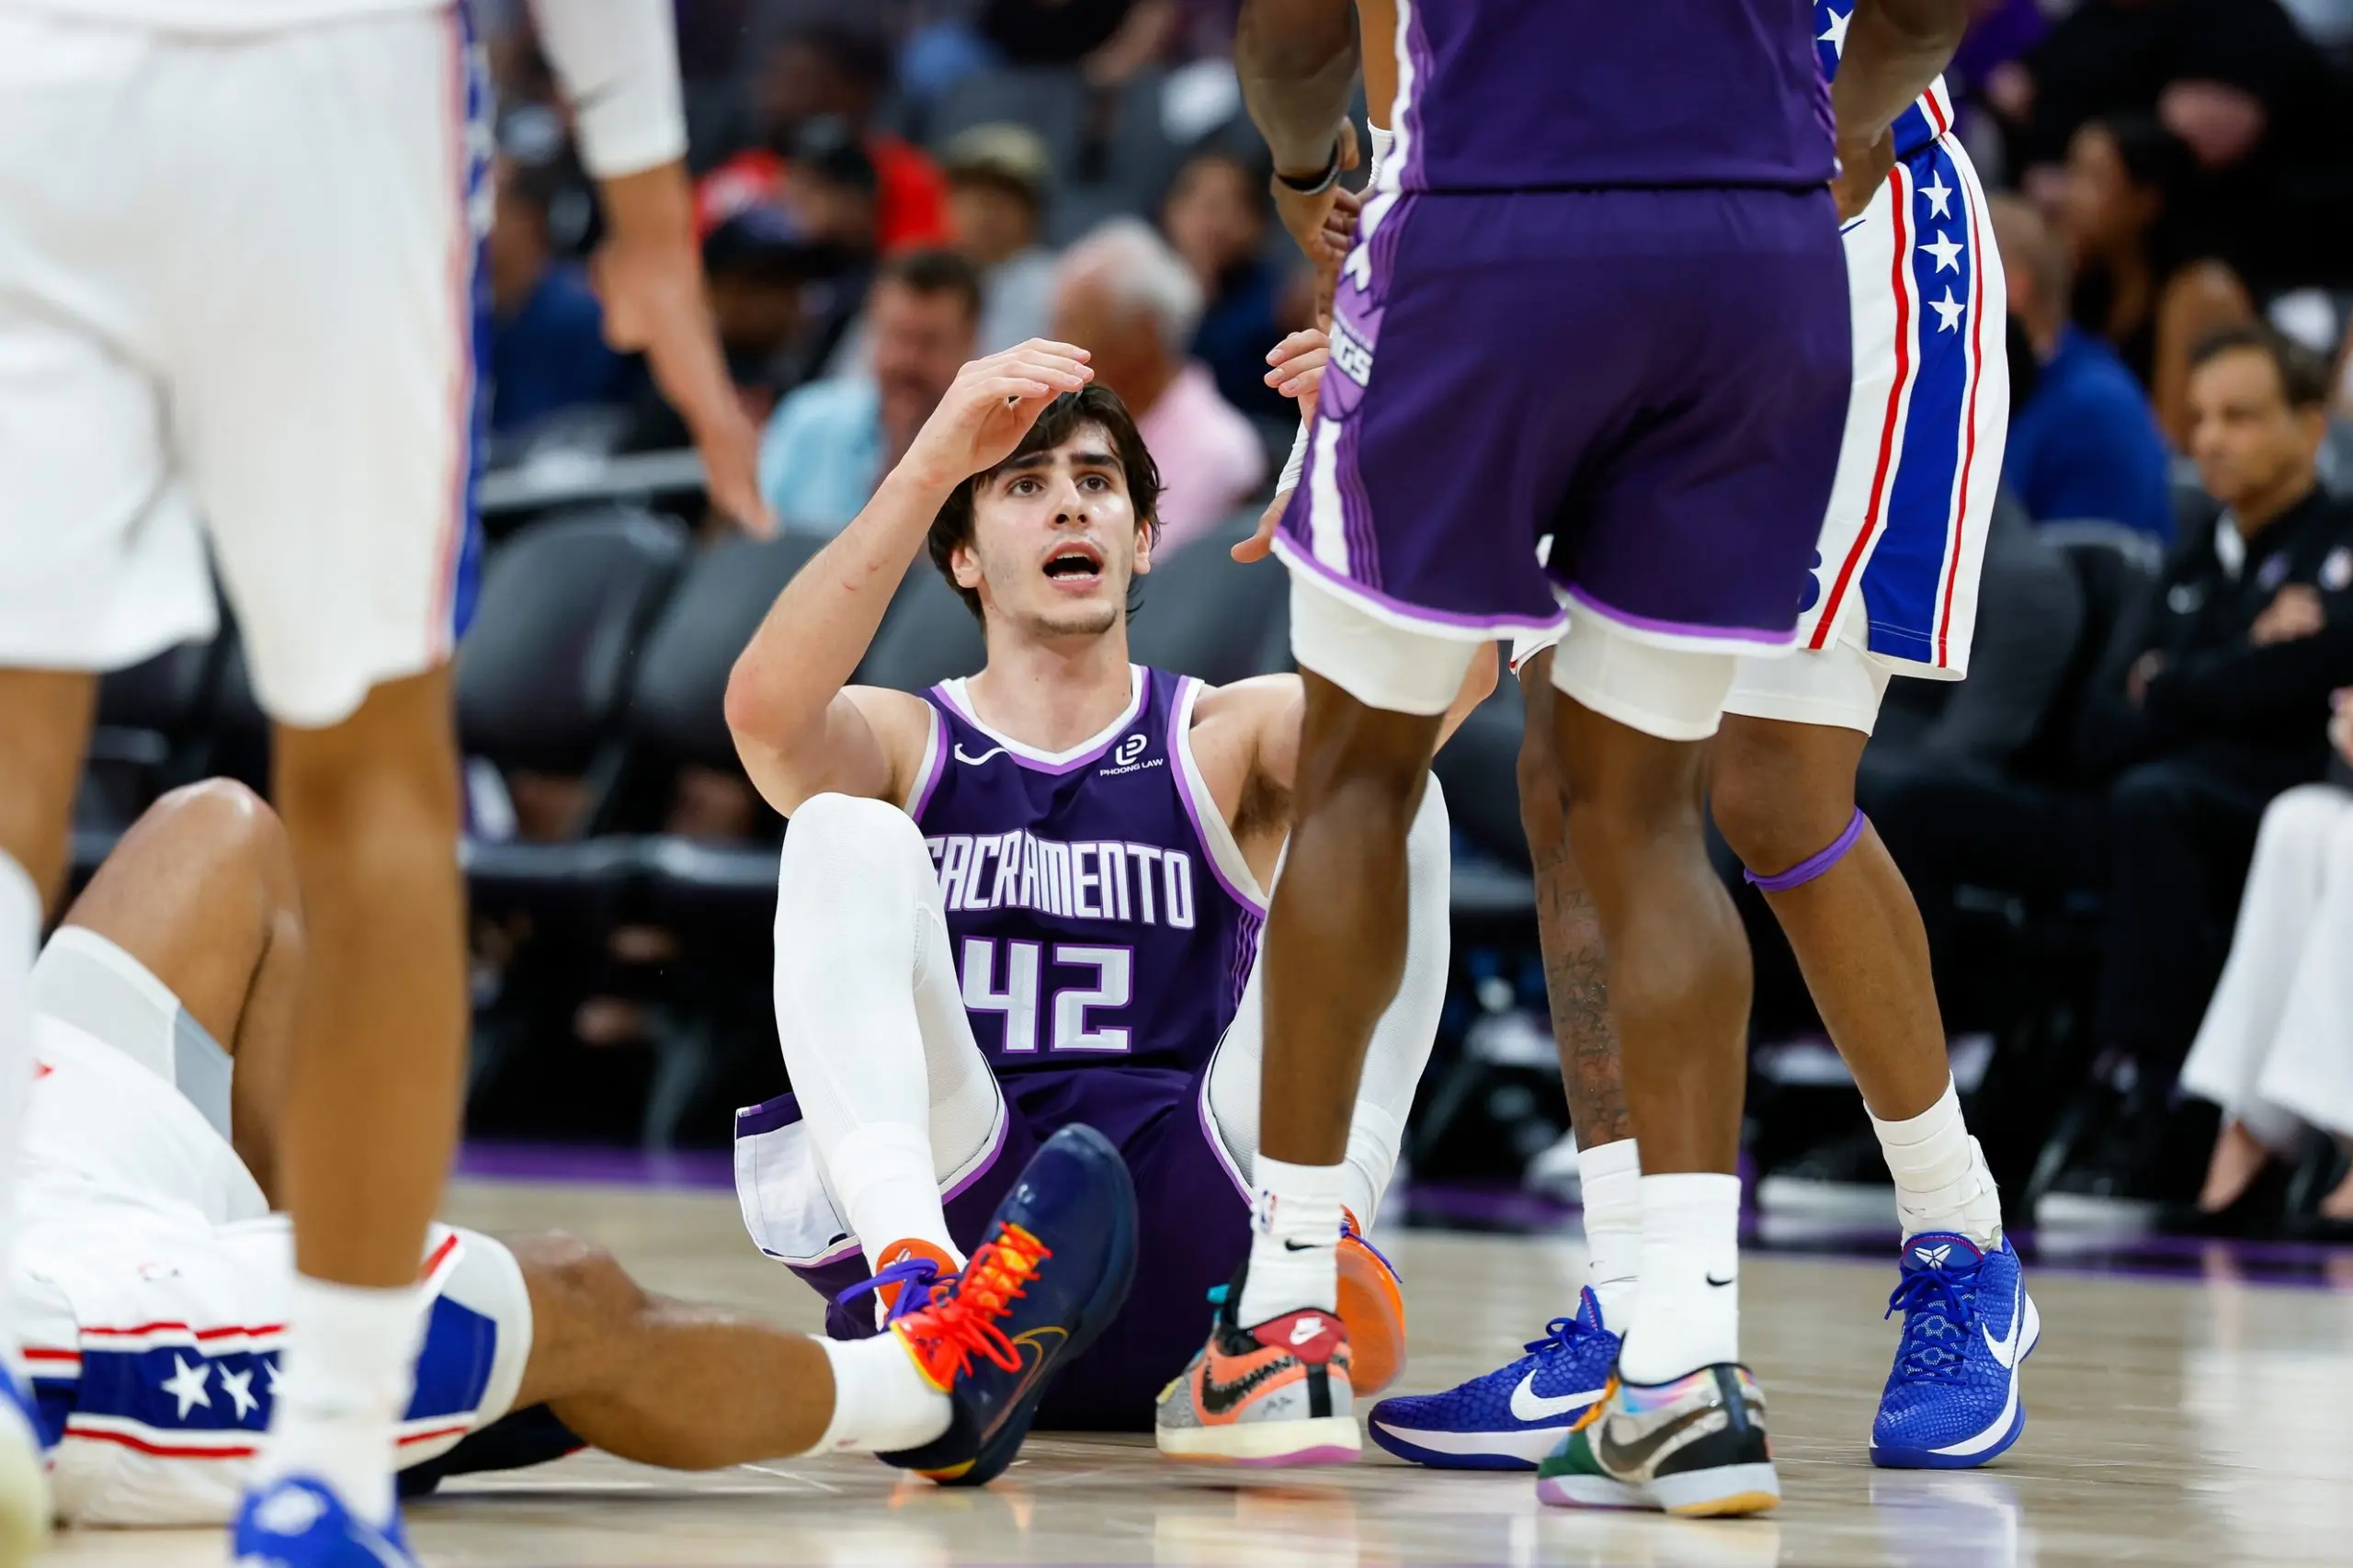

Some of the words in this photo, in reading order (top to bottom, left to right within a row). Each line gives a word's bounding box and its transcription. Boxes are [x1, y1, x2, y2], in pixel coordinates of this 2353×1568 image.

[1099, 763, 1141, 778] PHOONG
[1141, 757, 1164, 768] LAW
[959, 935, 1133, 1053] 42
